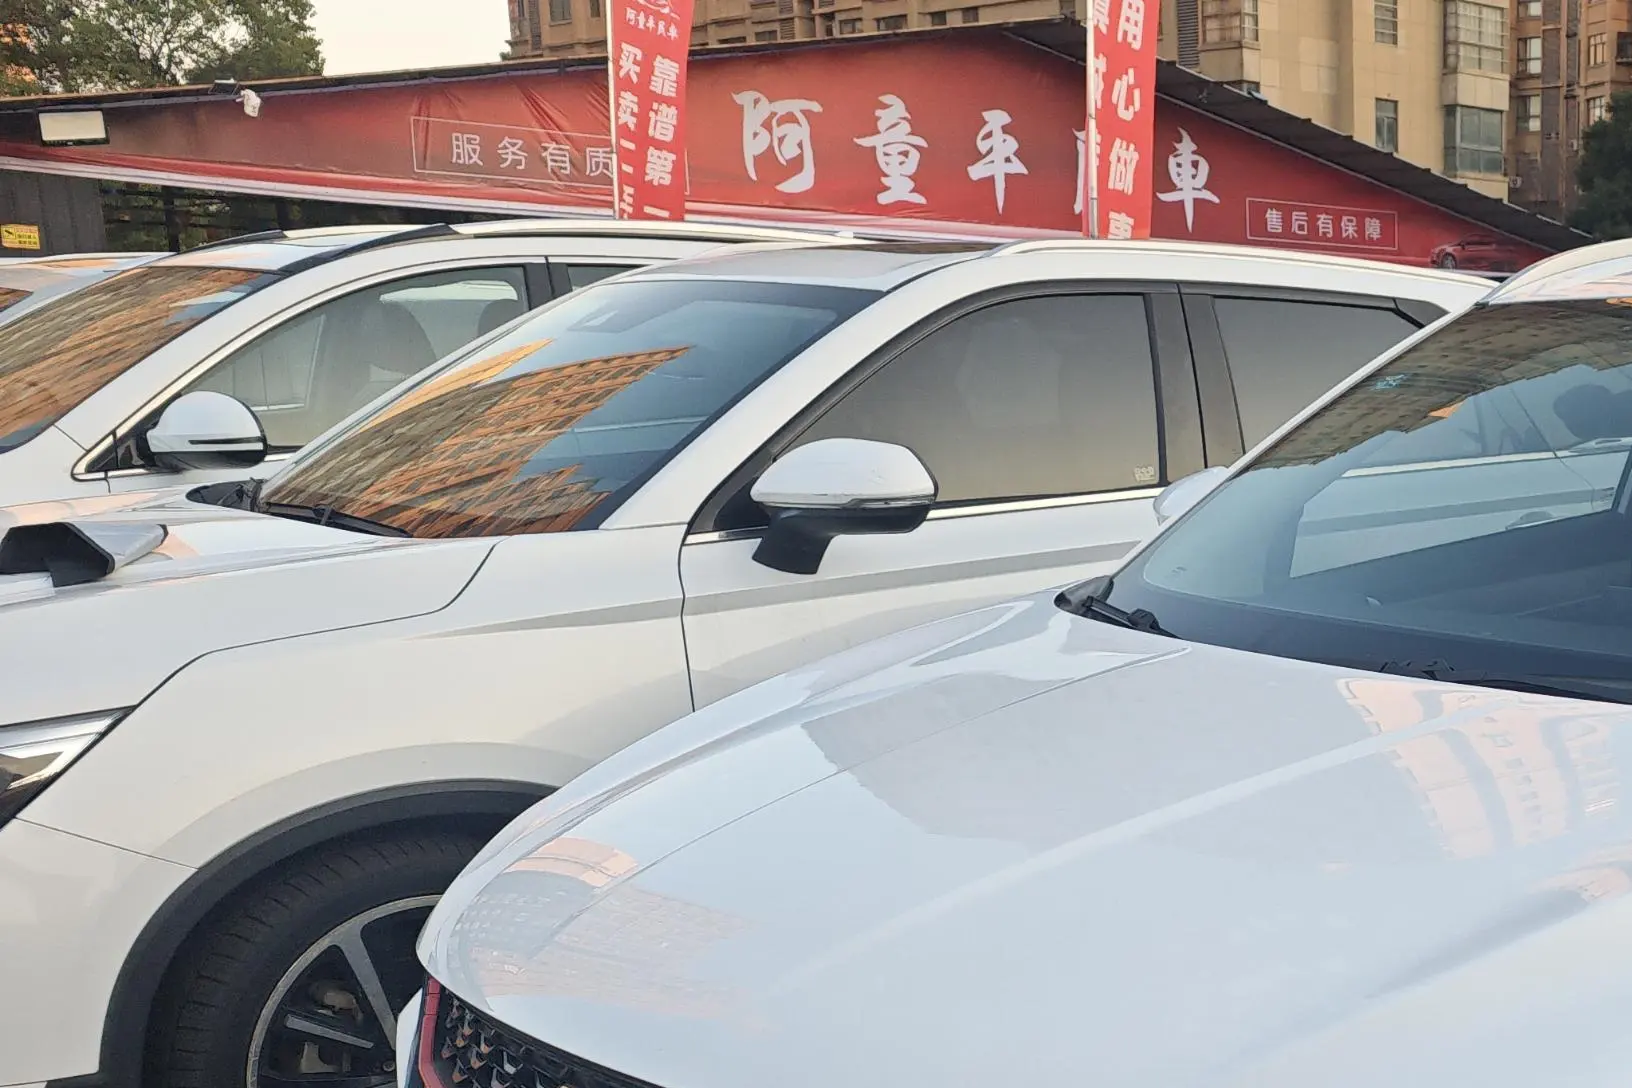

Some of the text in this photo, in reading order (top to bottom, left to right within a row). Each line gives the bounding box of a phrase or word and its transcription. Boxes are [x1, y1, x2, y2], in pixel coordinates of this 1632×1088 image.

[643, 54, 680, 218] 靠谱第一
[731, 90, 1220, 233] 阿童平車
[1265, 208, 1382, 241] 售后有保障
